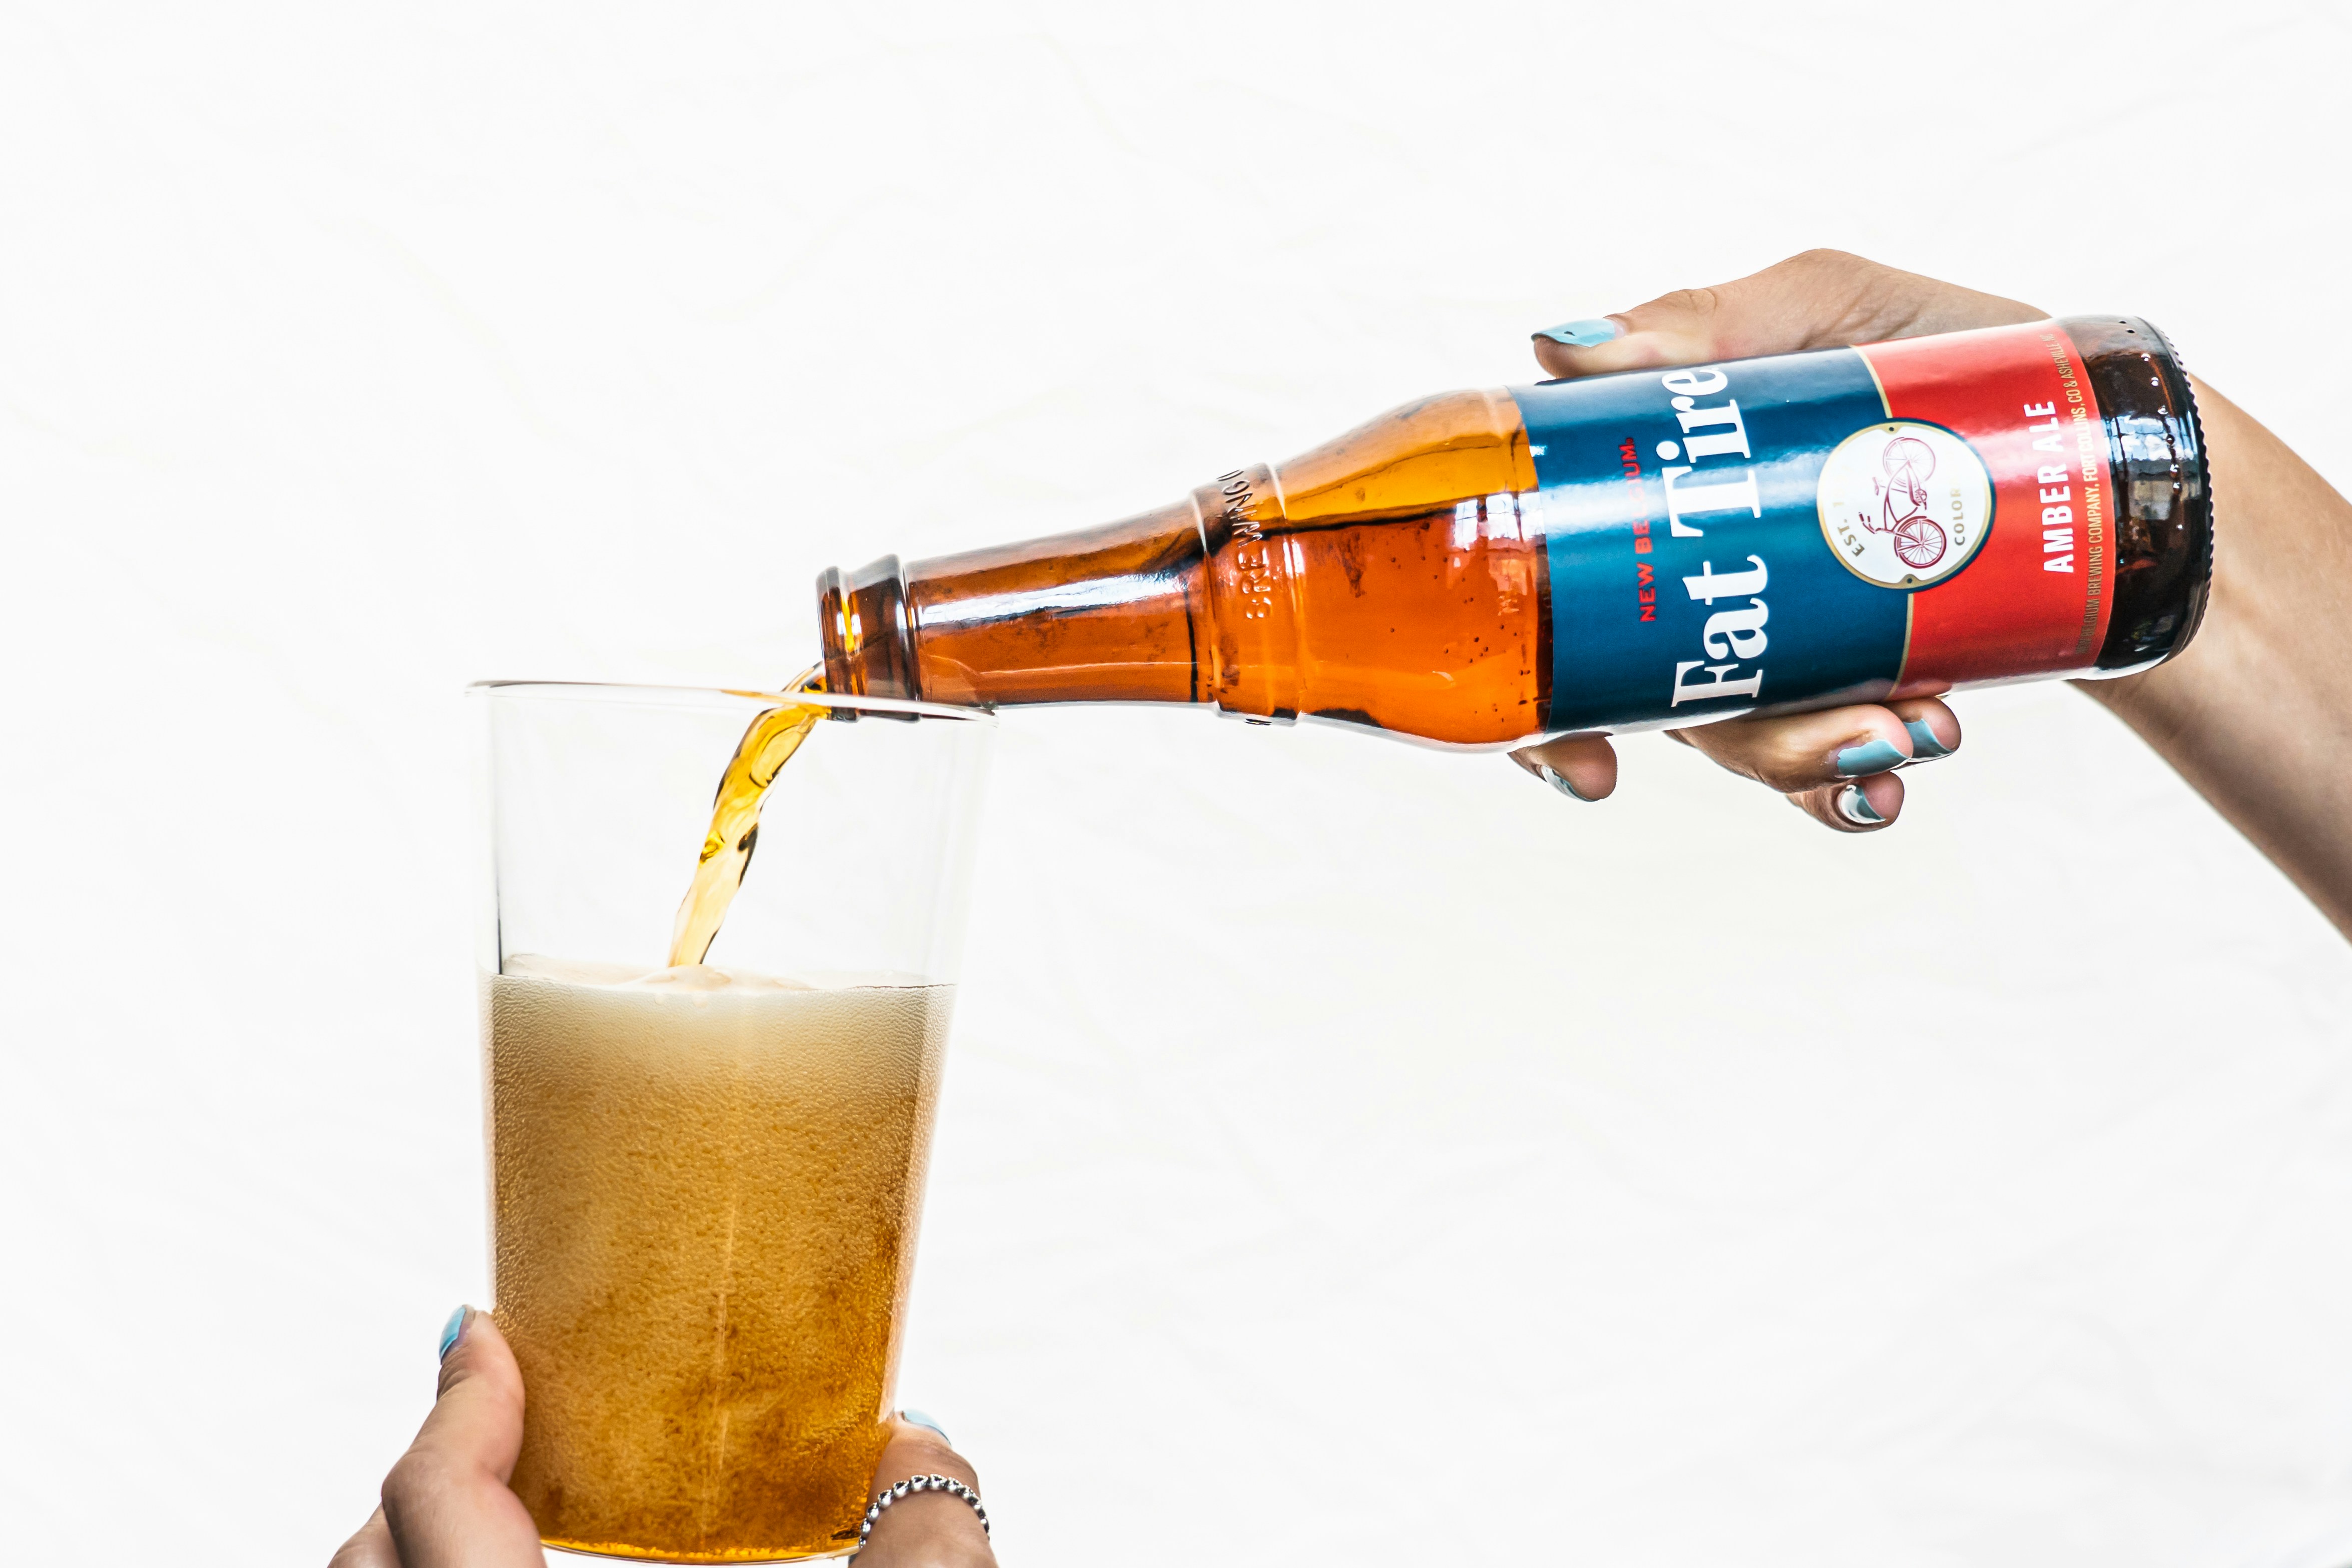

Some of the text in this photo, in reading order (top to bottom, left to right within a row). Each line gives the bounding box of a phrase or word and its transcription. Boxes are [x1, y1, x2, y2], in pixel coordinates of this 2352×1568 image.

[2063, 380, 2078, 388] &
[2066, 389, 2083, 403] CO
[2071, 403, 2094, 452] COLLINS,
[2023, 401, 2074, 574] AMBER ALE
[2080, 453, 2099, 482] FORT
[1656, 368, 1769, 708] Fat Tire
[1837, 518, 1865, 557] EST.
[2085, 483, 2103, 544] COMPANY,
[1221, 479, 1273, 619] BREWING
[2087, 546, 2103, 596] BREWING
[1636, 562, 1657, 622] NEW
[2080, 599, 2100, 637] BELGIUM
